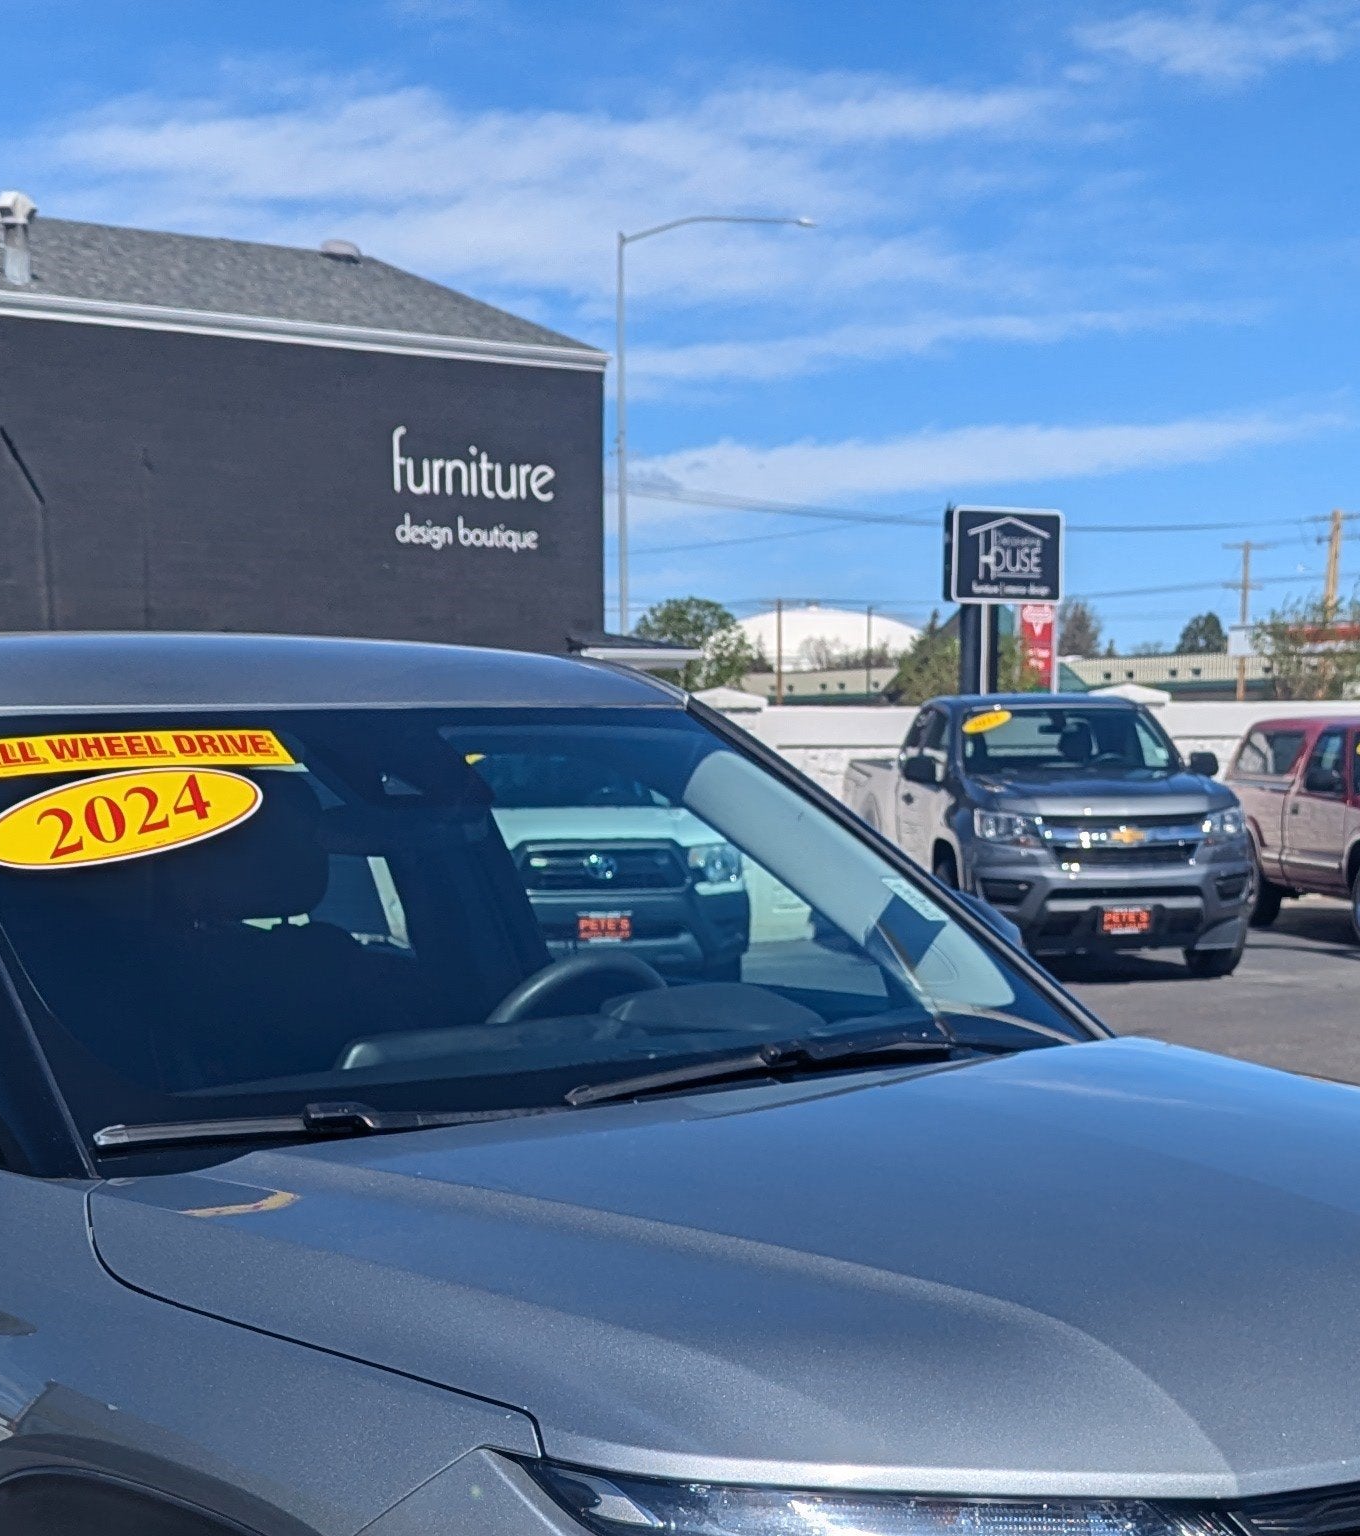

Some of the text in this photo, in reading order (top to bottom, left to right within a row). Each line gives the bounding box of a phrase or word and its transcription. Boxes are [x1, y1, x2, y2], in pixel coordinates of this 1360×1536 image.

[392, 425, 556, 502] furniture
[395, 512, 539, 553] design boutique
[45, 735, 172, 762] WHEEL
[172, 733, 276, 758] DRIVE
[36, 774, 211, 859] 2024
